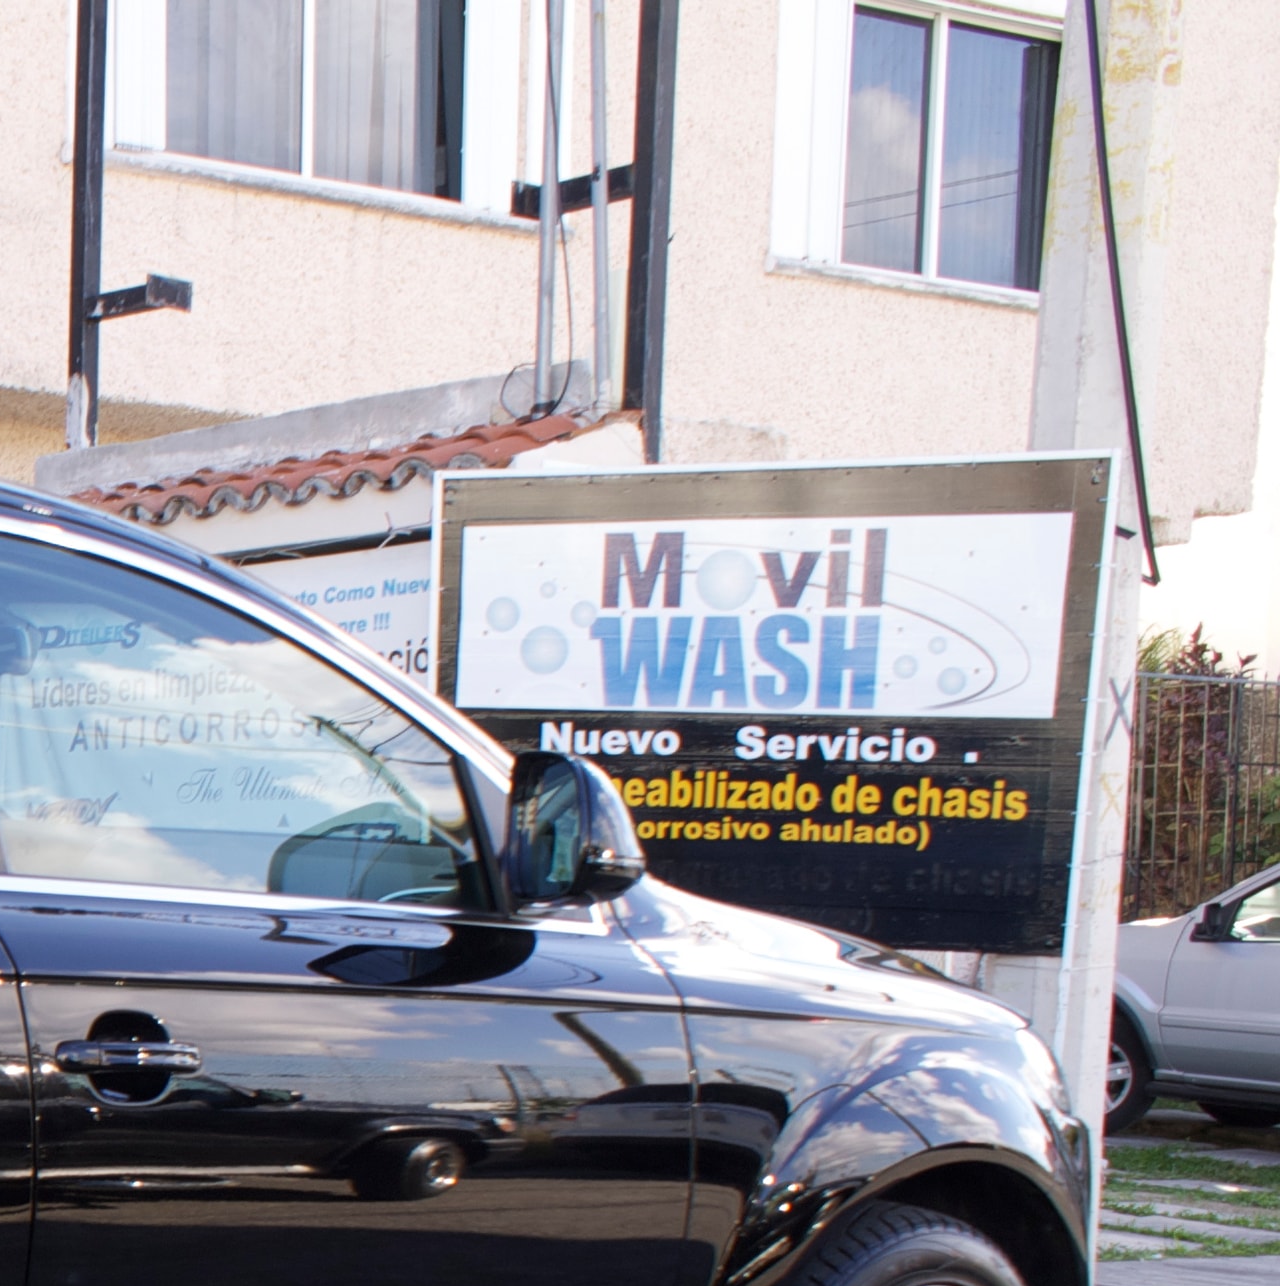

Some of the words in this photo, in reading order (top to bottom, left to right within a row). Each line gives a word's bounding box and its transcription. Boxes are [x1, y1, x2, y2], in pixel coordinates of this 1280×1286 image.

[324, 586, 376, 604] Como
[589, 613, 880, 709] WASH
[117, 681, 145, 702] en
[153, 664, 256, 704] limpieza
[541, 722, 680, 757] Nuevo
[735, 726, 937, 763] Servicio
[177, 766, 223, 805] The
[831, 774, 881, 815] de
[892, 776, 1028, 821] chasis
[780, 816, 929, 852] ahulado)
